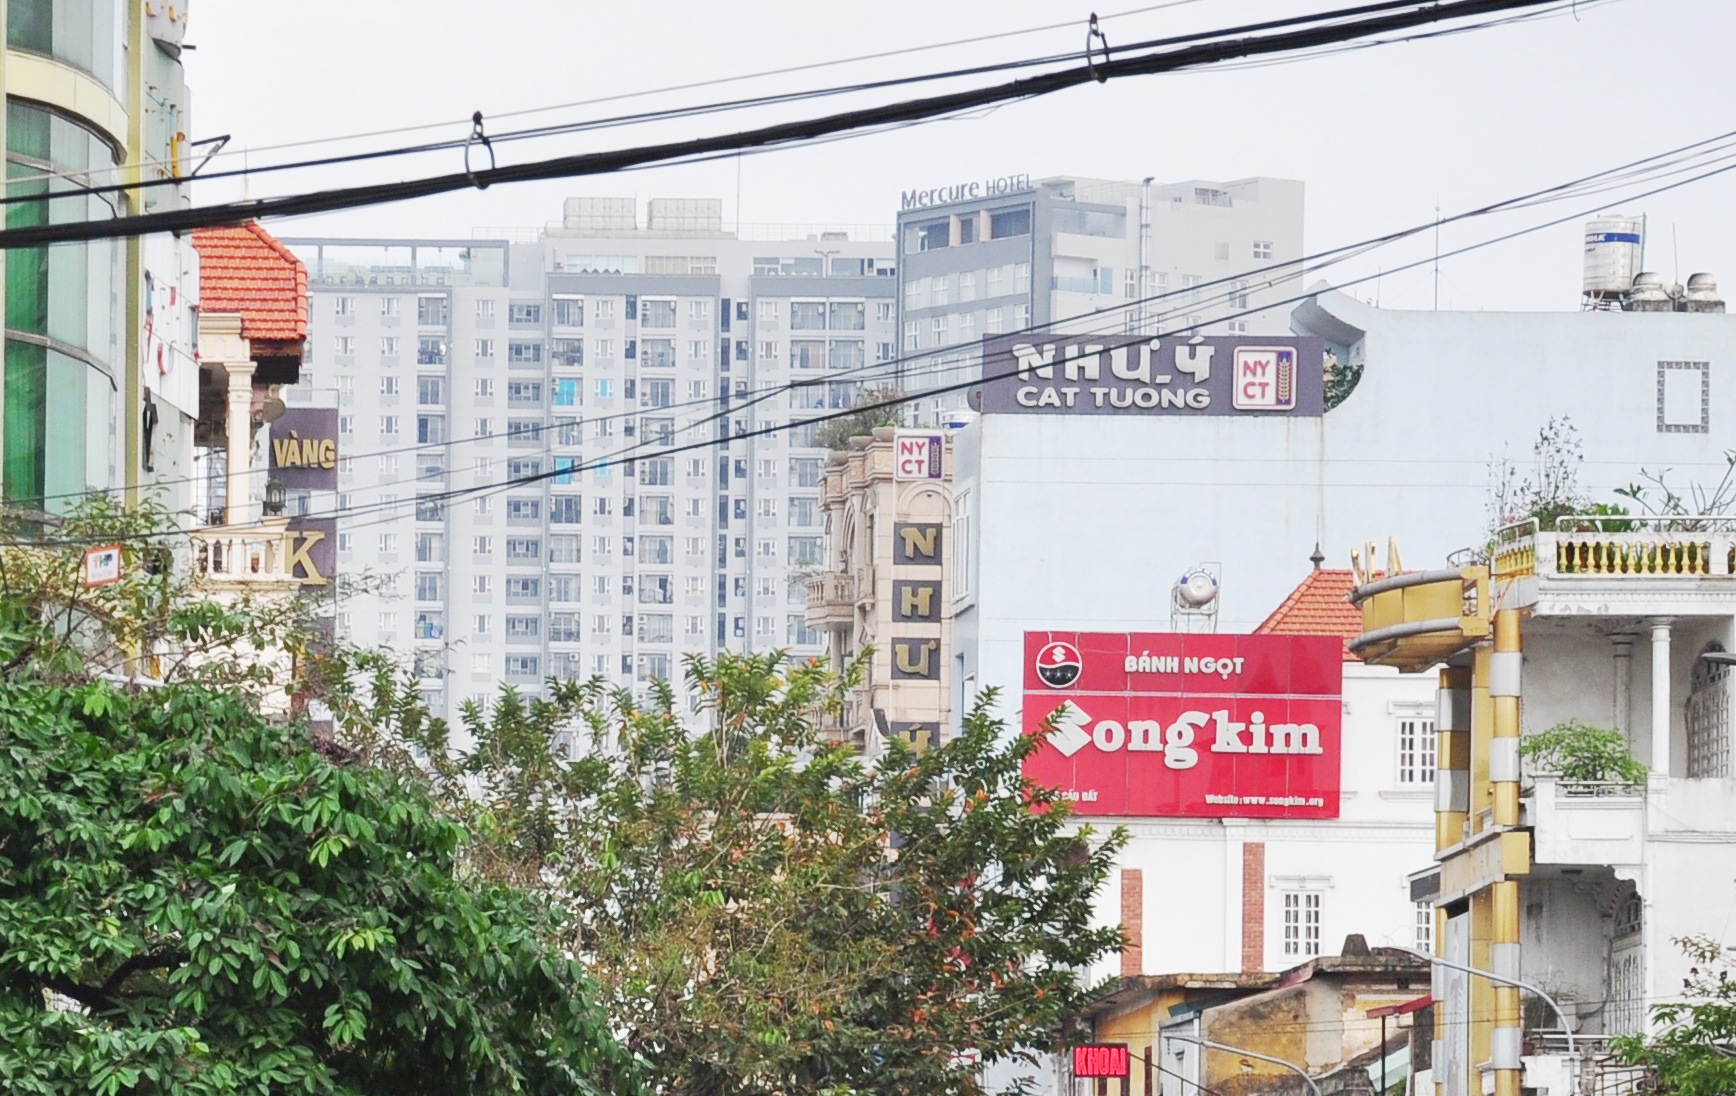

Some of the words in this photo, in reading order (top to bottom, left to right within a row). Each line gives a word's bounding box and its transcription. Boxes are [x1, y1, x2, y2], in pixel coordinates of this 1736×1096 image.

[901, 181, 980, 210] Mercure
[985, 173, 1034, 197] HOTEL
[1242, 359, 1271, 378] NY
[1242, 381, 1270, 399] CT
[273, 429, 336, 470] VÀNG
[900, 440, 927, 455] NY
[900, 459, 926, 475] CT
[1124, 650, 1179, 674] BÁNH
[1184, 656, 1245, 681] NGỌT
[1075, 1047, 1126, 1076] KHOAI
